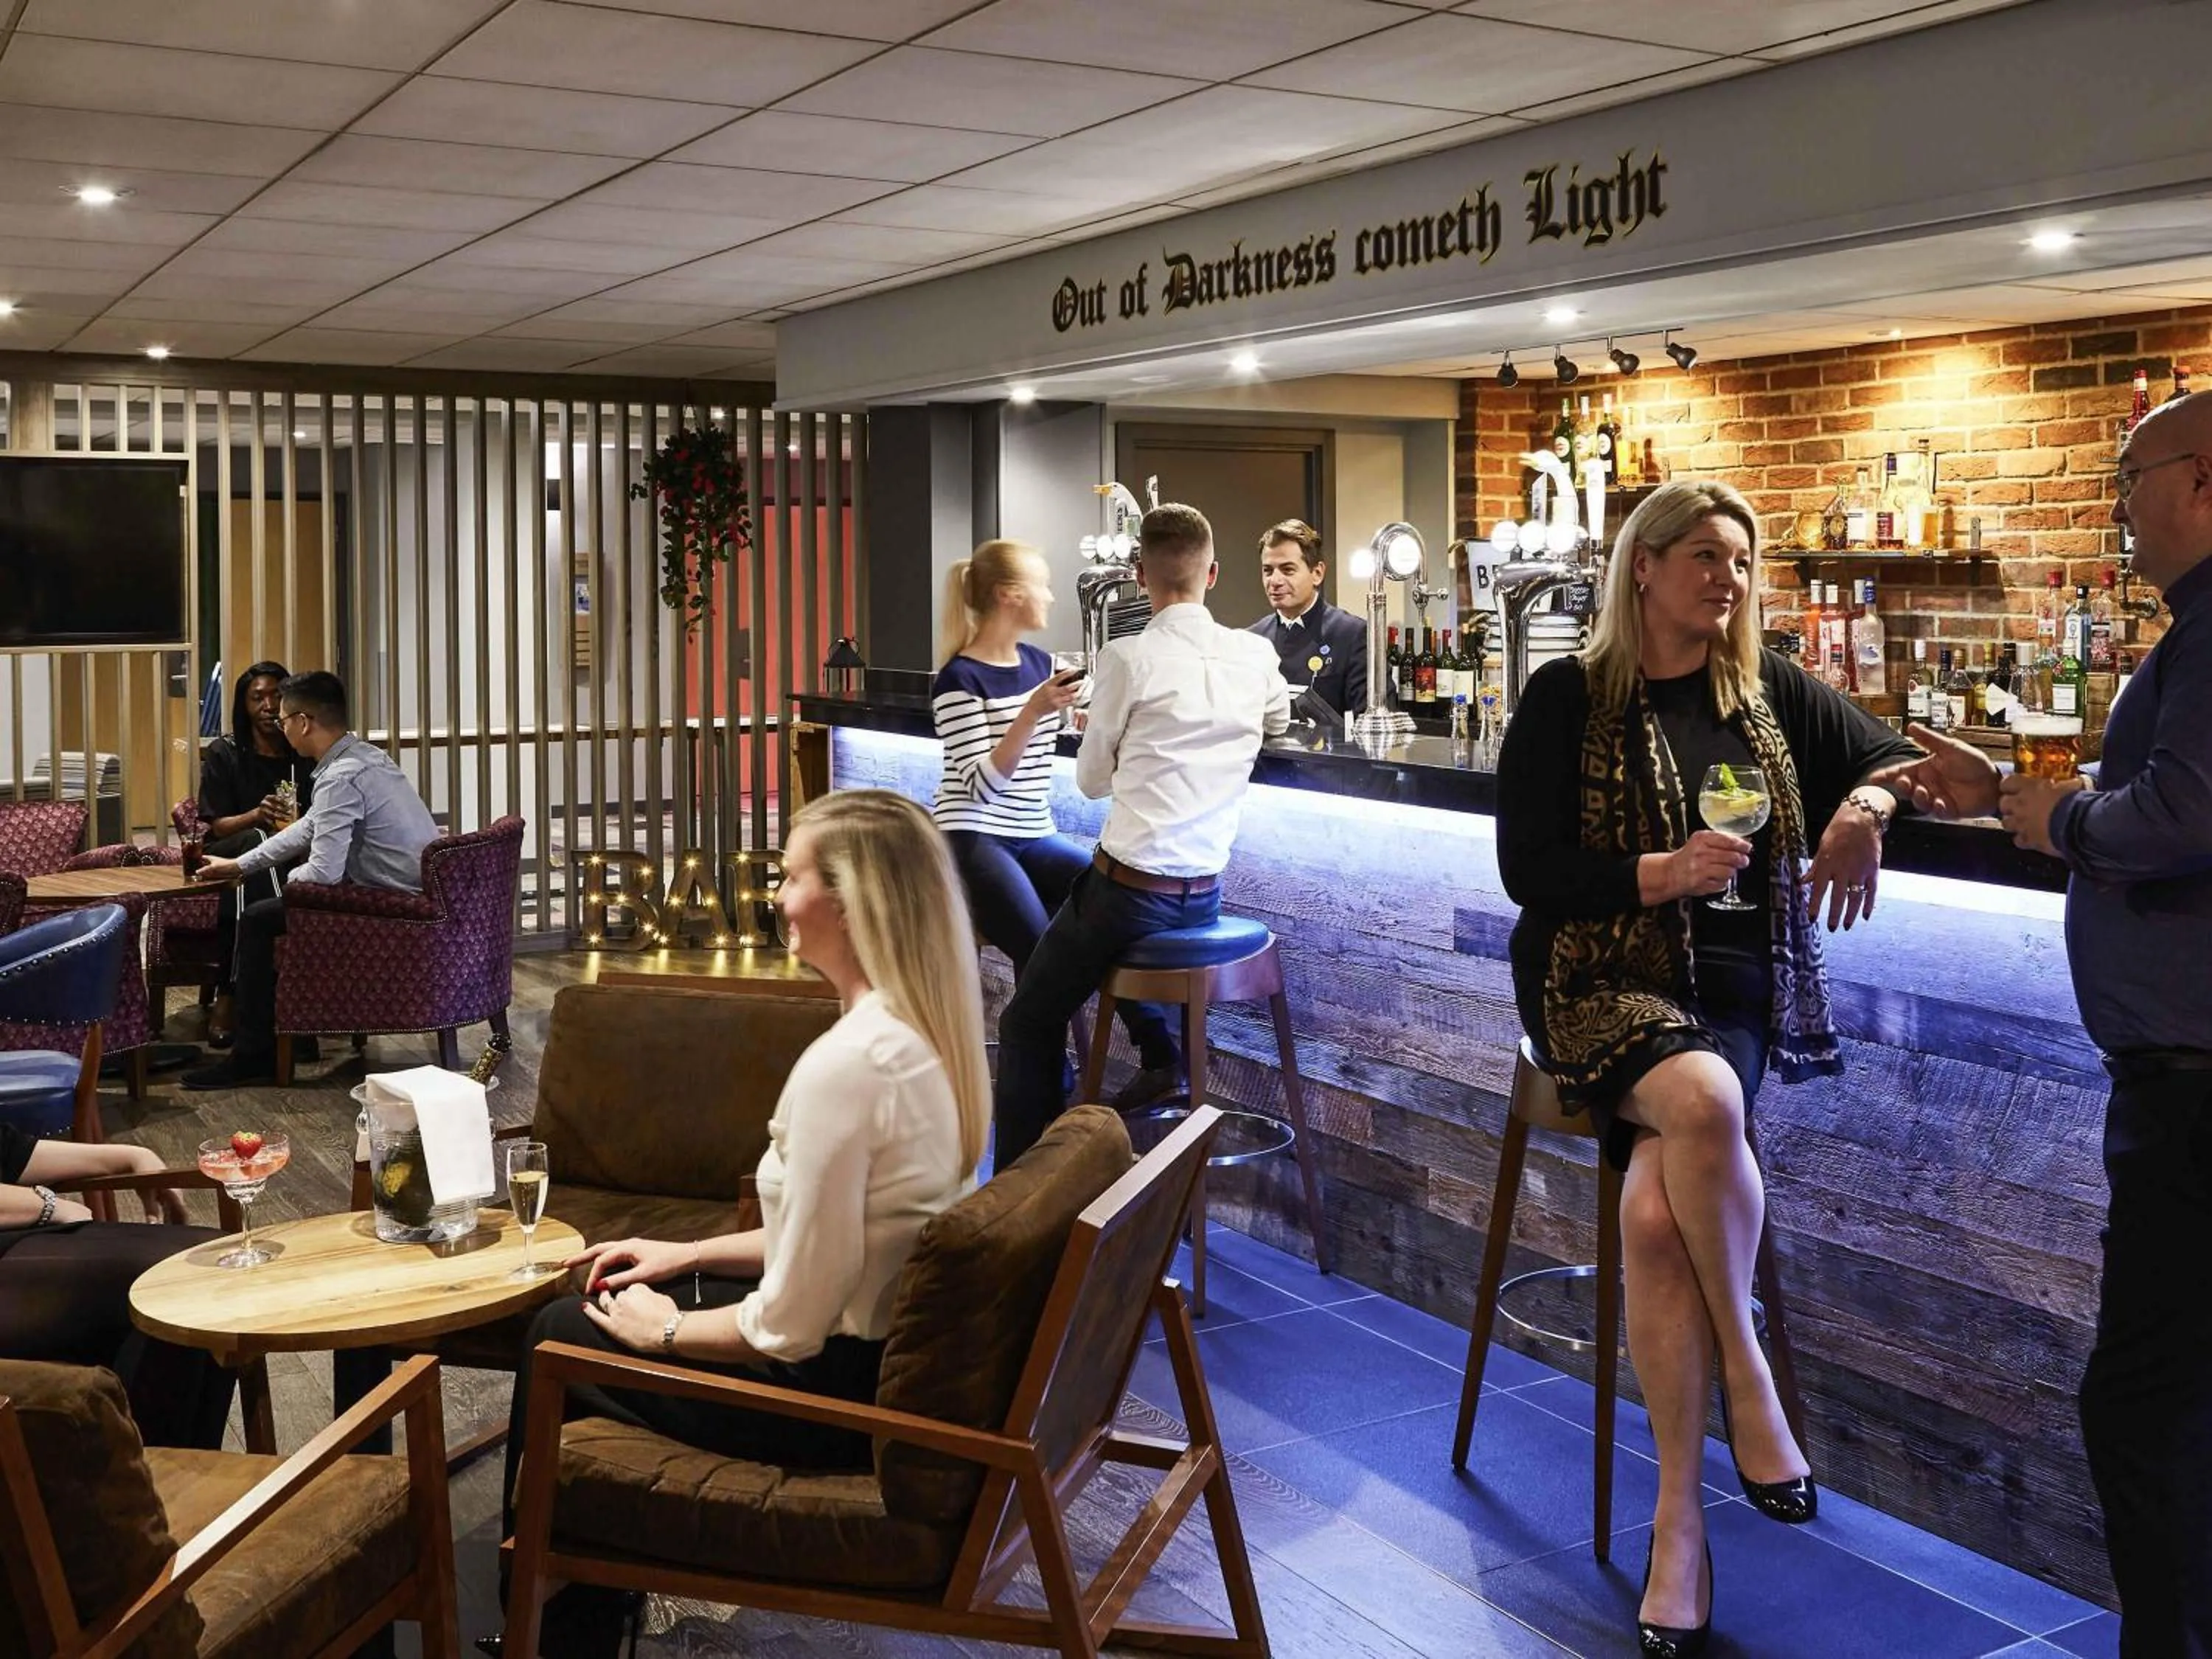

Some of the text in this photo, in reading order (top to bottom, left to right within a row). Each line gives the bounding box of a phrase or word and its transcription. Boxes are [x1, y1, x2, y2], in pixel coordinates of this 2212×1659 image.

[1052, 148, 1668, 333] Out of Darkness cometh Light
[571, 849, 790, 950] BAR
